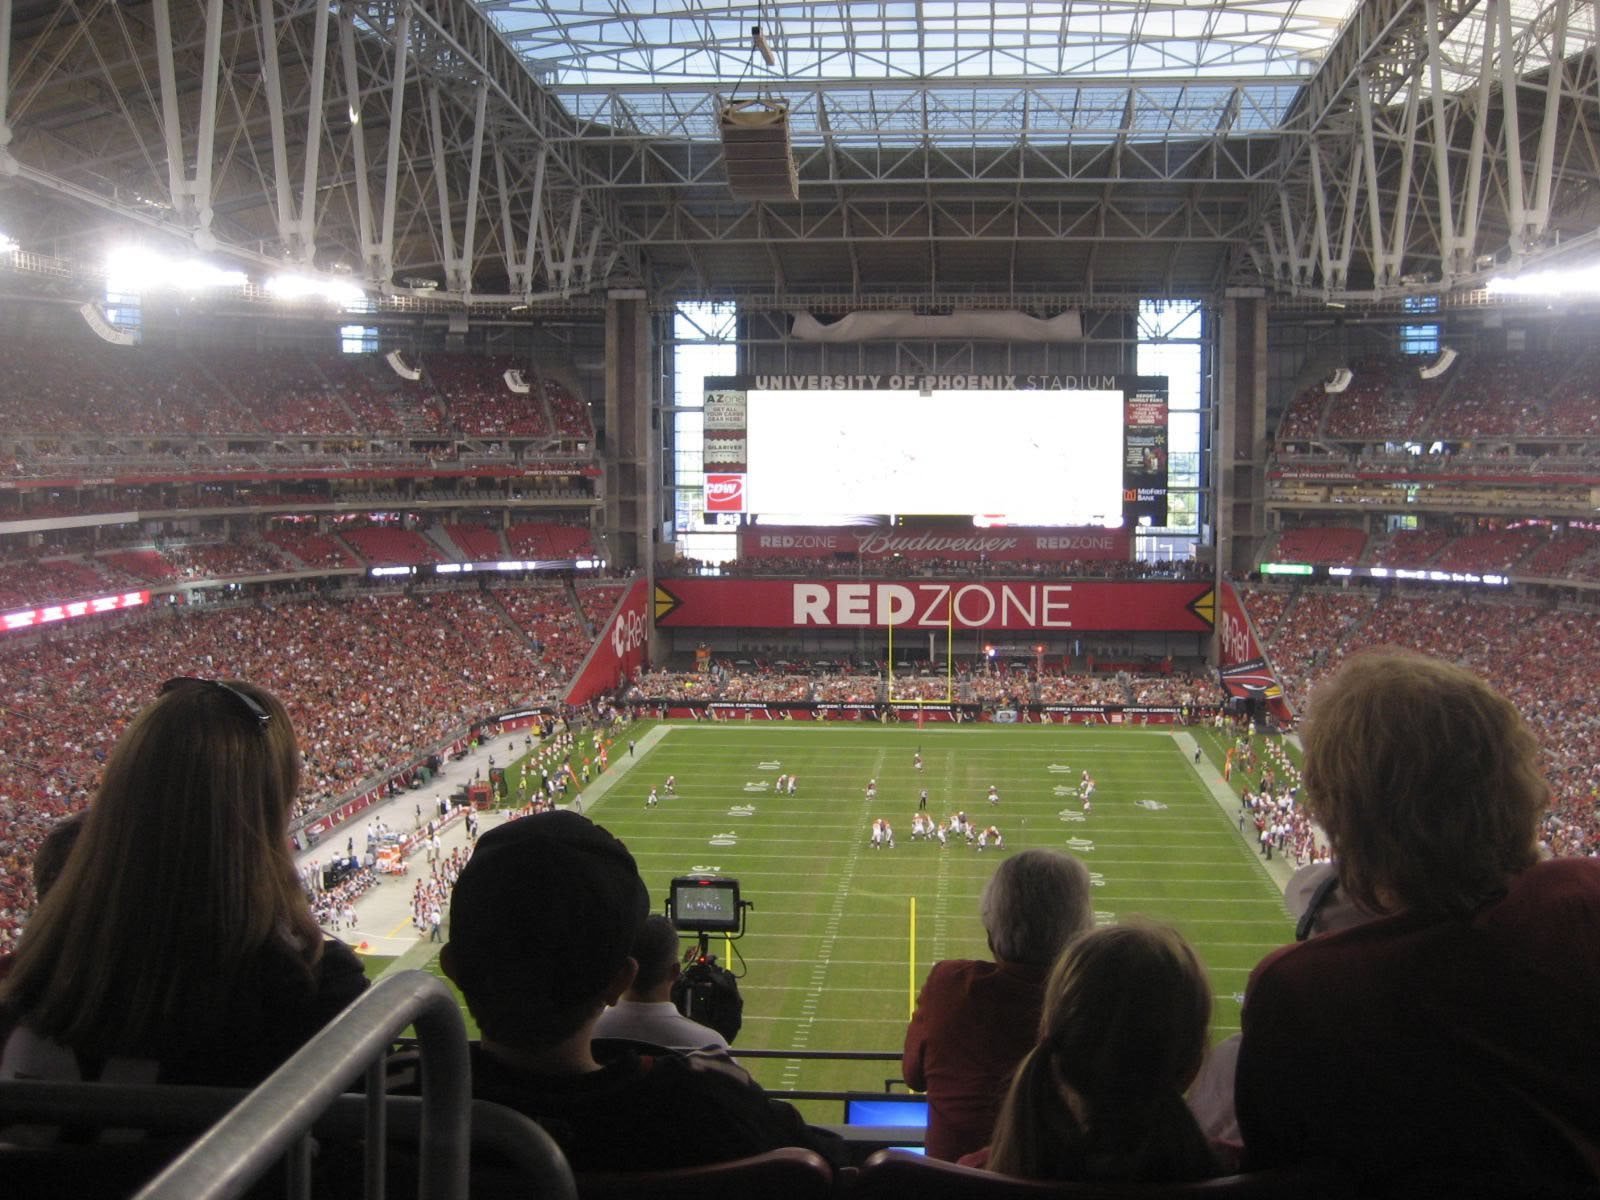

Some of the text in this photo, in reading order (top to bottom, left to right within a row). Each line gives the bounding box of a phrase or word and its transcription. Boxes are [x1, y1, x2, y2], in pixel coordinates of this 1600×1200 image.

[755, 375, 1116, 390] UNIVERSITY OF PHOENIX STADIUM
[705, 484, 737, 494] CDW
[852, 529, 1017, 554] Budweiser
